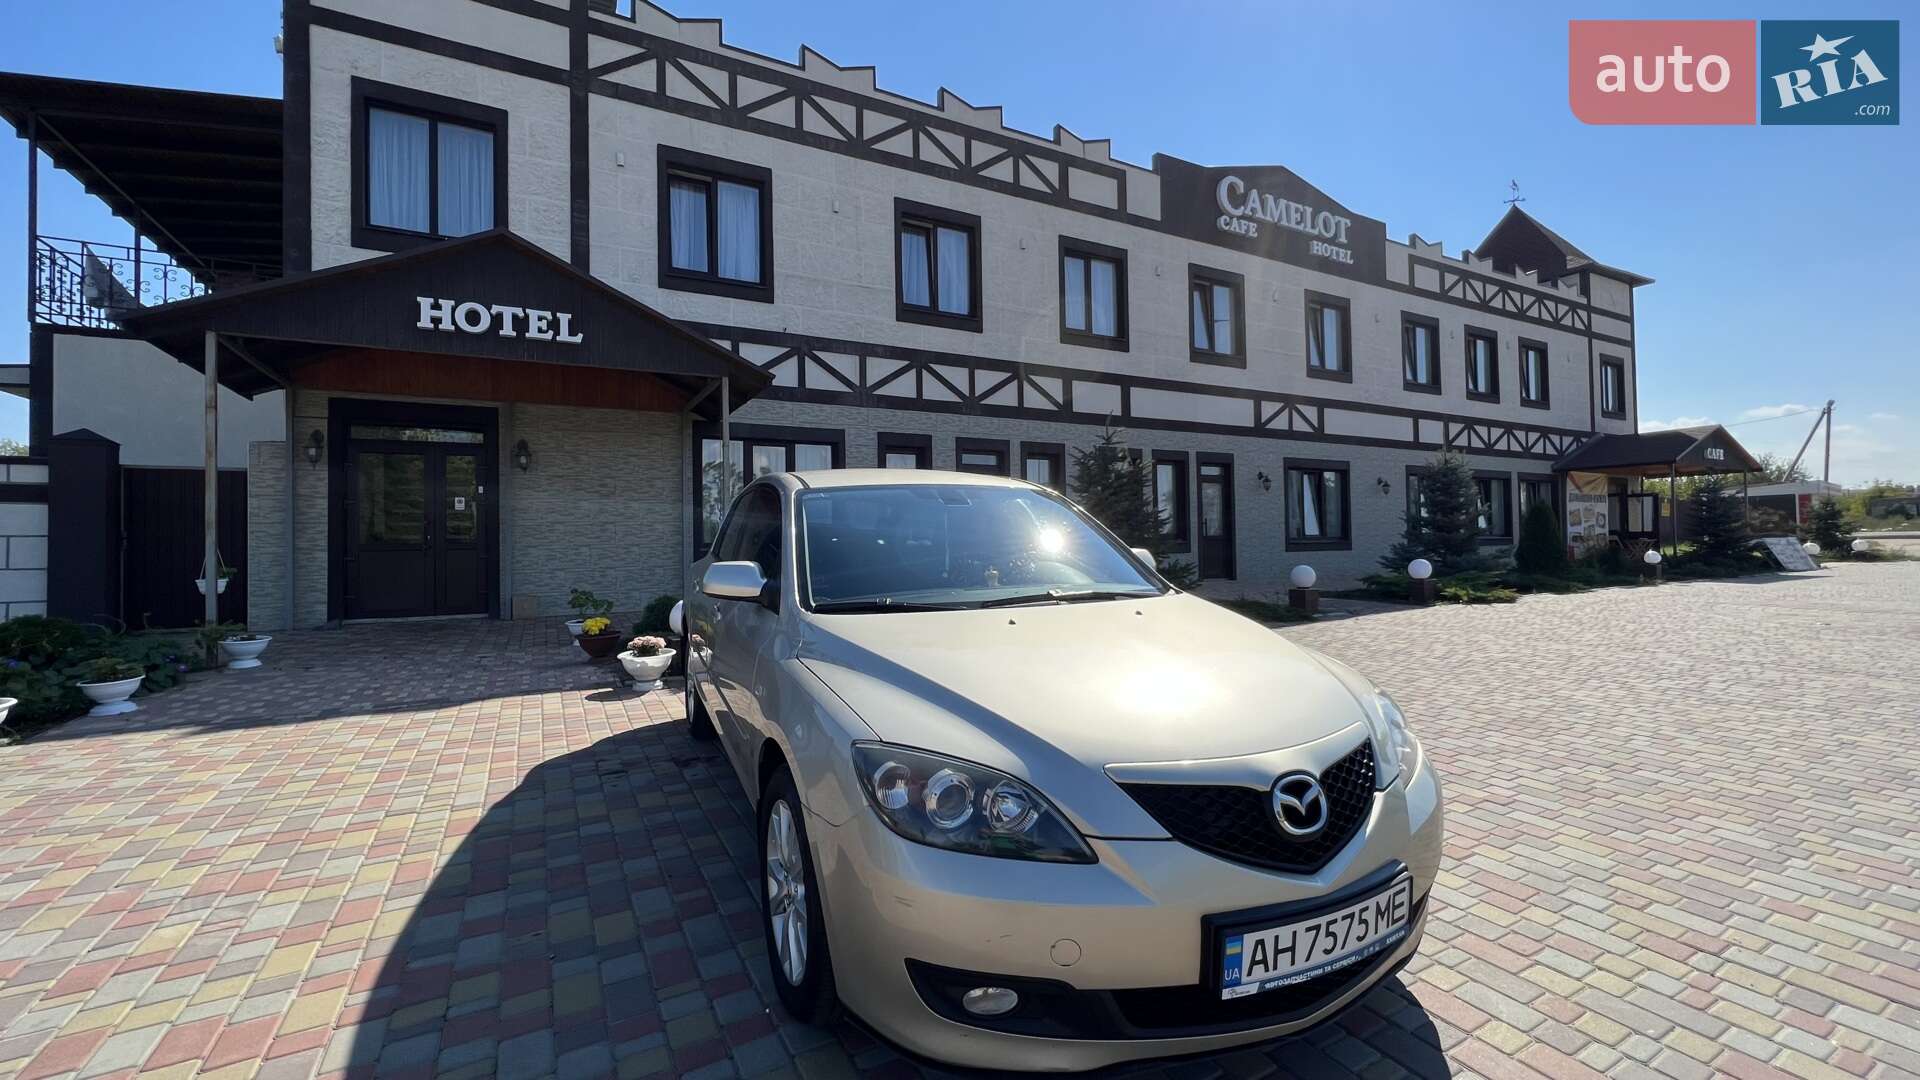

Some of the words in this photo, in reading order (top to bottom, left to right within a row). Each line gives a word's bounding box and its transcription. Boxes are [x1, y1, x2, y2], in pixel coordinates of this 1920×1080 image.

[1216, 175, 1351, 243] CAMELOT
[1217, 215, 1258, 238] CAFE
[1310, 240, 1354, 265] HOTEL
[416, 296, 584, 344] HOTEL
[1706, 447, 1724, 461] CAFE
[1224, 967, 1240, 981] UA
